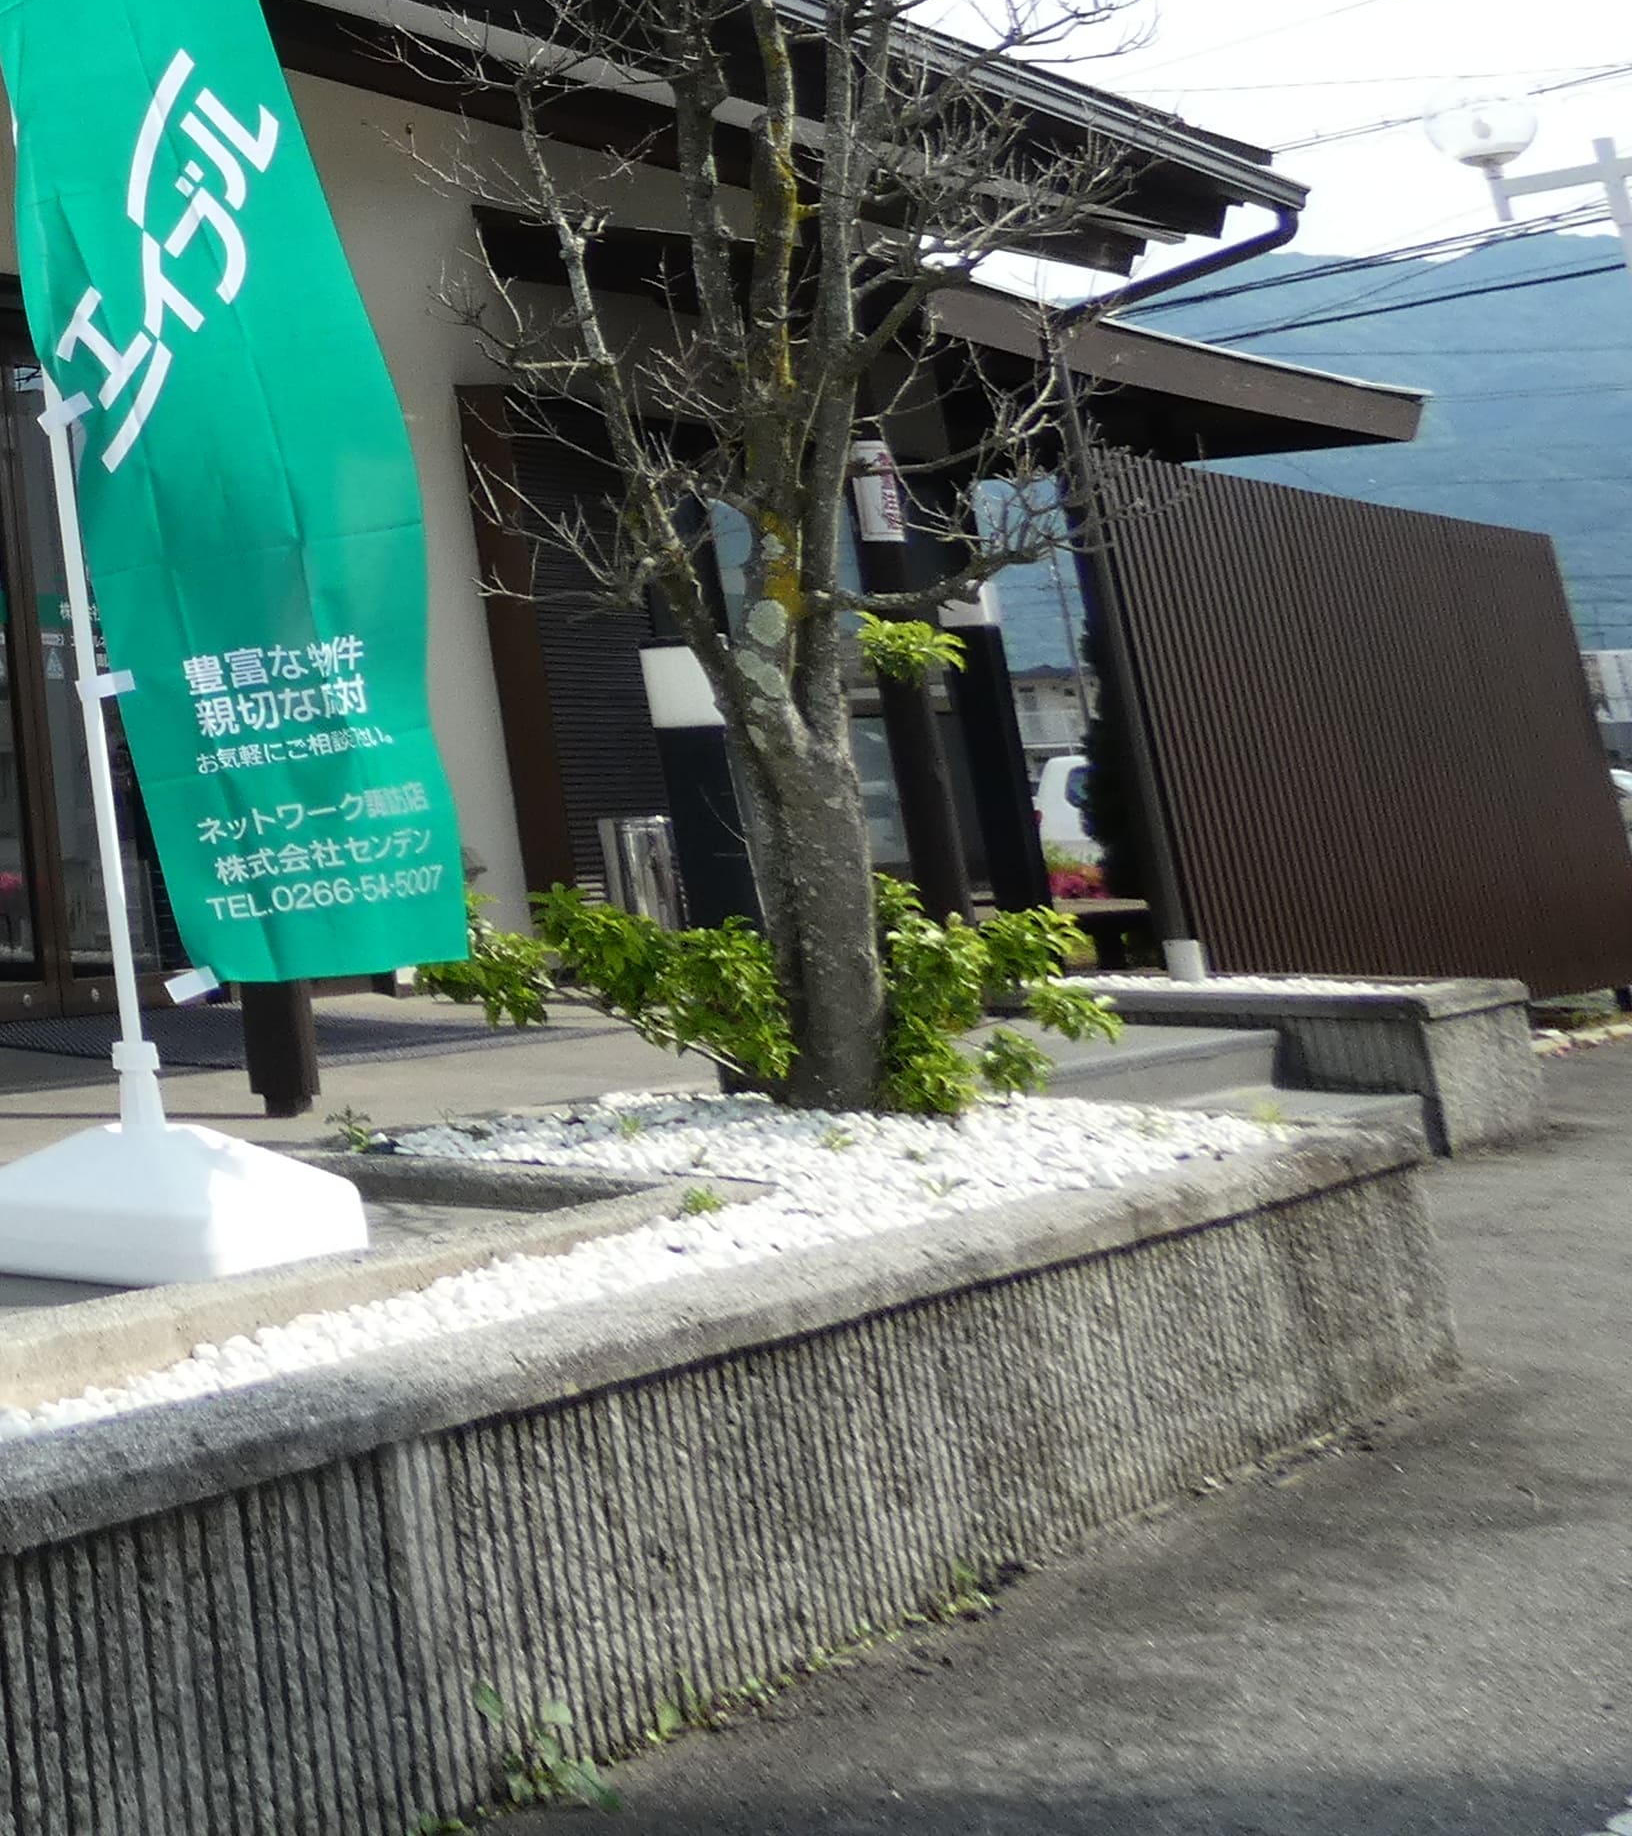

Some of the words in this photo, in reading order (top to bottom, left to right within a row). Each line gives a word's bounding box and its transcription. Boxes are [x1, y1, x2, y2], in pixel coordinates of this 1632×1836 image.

[56, 48, 279, 474] エイブル
[183, 635, 364, 696] 豊富な物件
[214, 828, 431, 886] 株式会社センデン
